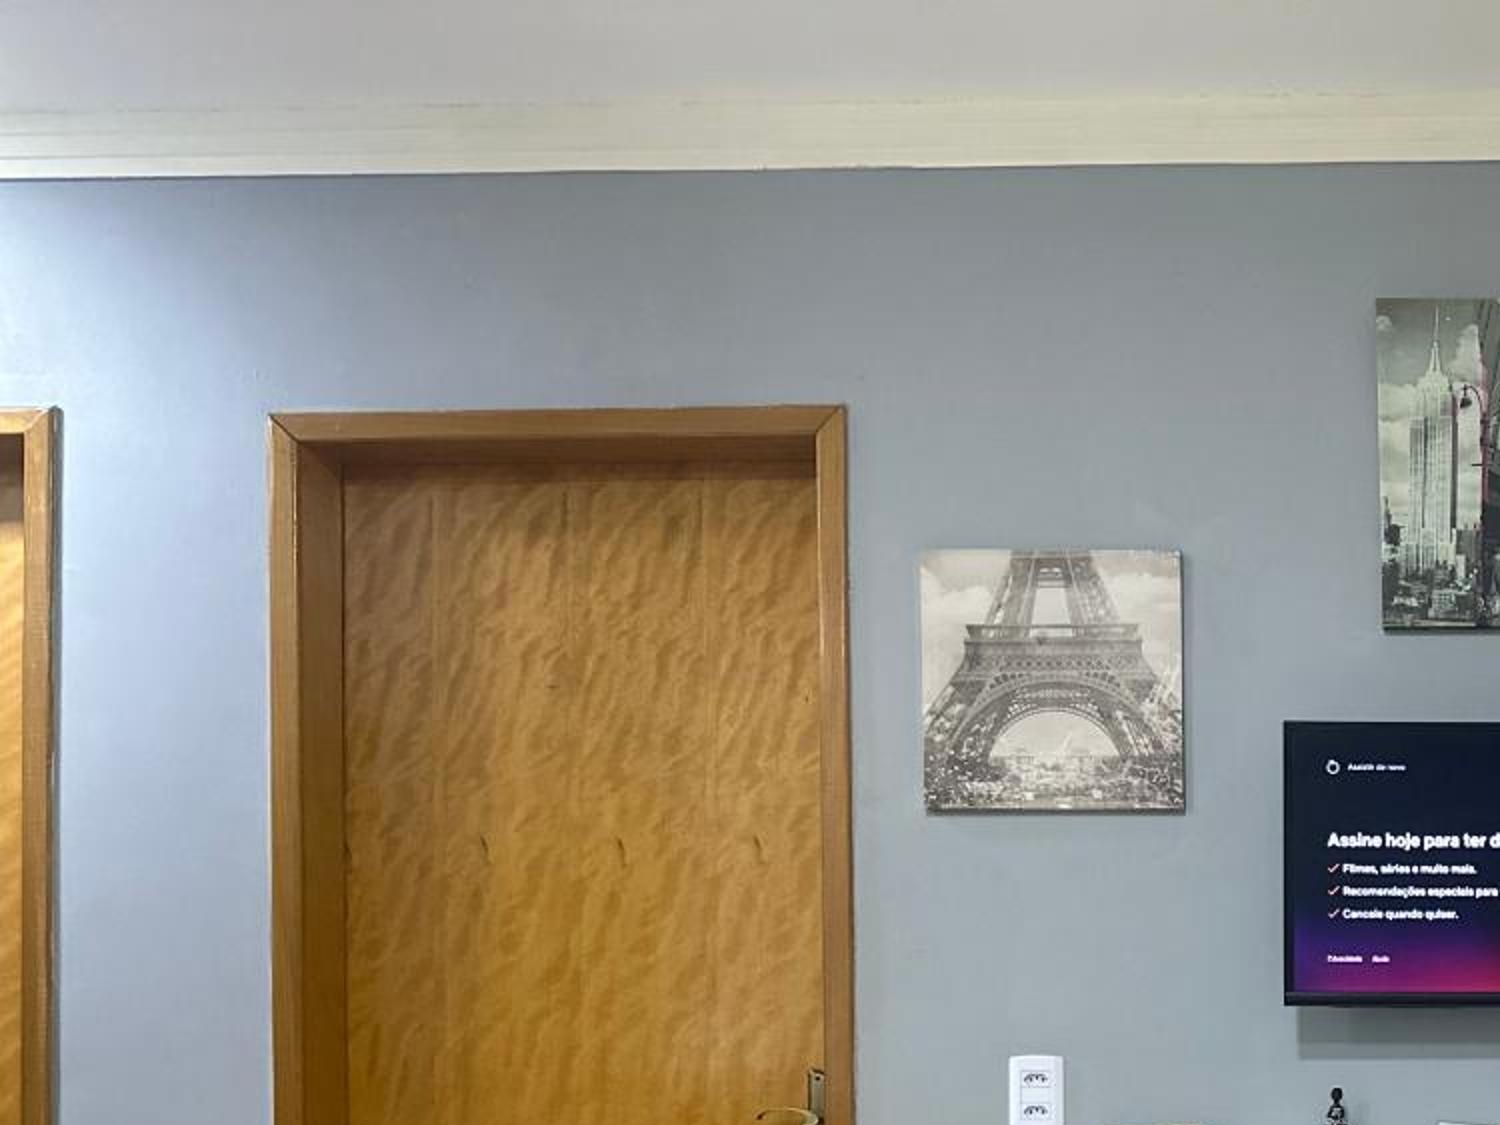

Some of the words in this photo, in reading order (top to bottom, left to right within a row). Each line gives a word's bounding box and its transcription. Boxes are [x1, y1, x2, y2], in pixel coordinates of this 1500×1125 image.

[1327, 832, 1382, 848] Assine
[1385, 832, 1420, 851] hoje
[1423, 834, 1460, 851] para
[1463, 833, 1487, 848] ter
[1343, 864, 1379, 875] Filmes,
[1380, 864, 1411, 874] séries
[1412, 866, 1418, 874] e
[1420, 864, 1449, 874] muito
[1451, 864, 1477, 875] mais.
[1343, 886, 1426, 898] Recomendações
[1428, 886, 1474, 898] especiais
[1476, 887, 1498, 898] para
[1385, 909, 1423, 920] quando
[1425, 909, 1459, 920] quiser.
